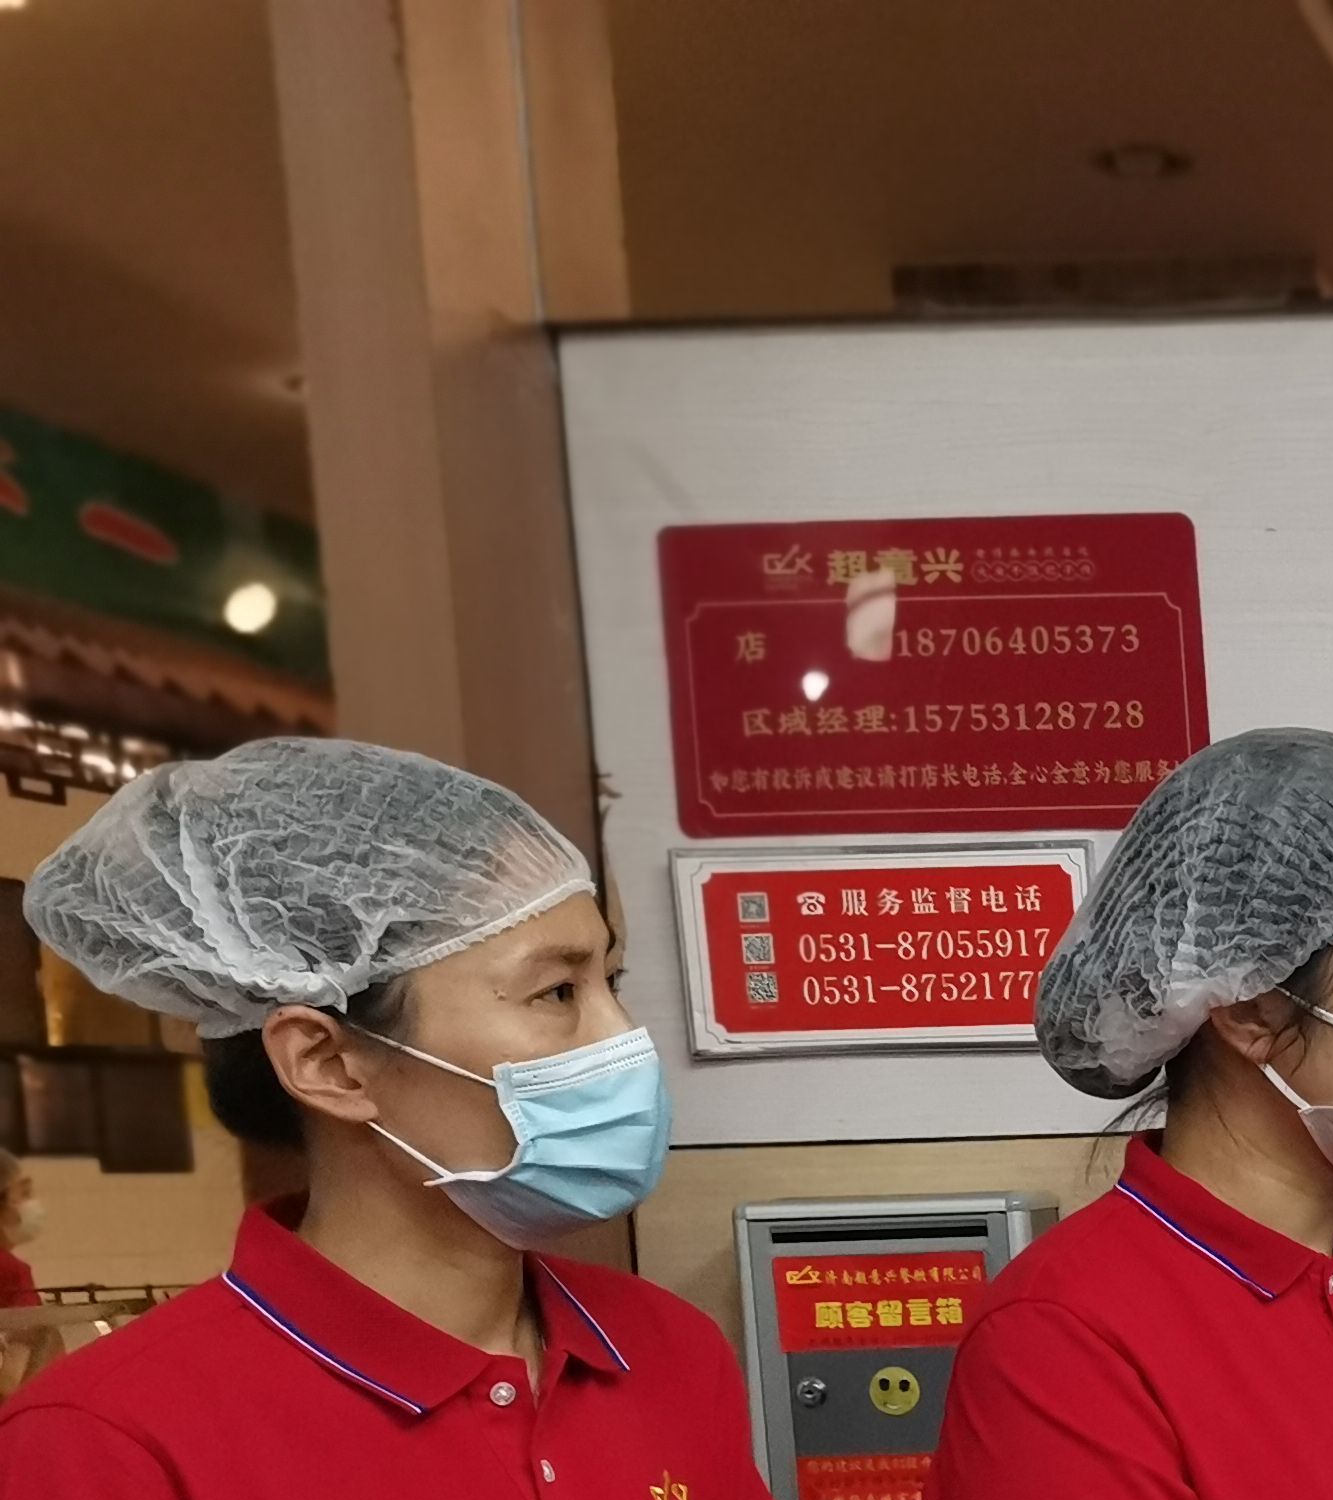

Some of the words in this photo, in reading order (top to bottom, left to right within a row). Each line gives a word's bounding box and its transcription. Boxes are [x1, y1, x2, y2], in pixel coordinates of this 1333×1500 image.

[897, 624, 1140, 657] 18706405373
[840, 884, 1042, 917] 服务监督电话
[798, 927, 1051, 964] 0531-87055917
[803, 971, 1044, 1006] 0531-8752177
[815, 1297, 964, 1329] 顾客留言箱
